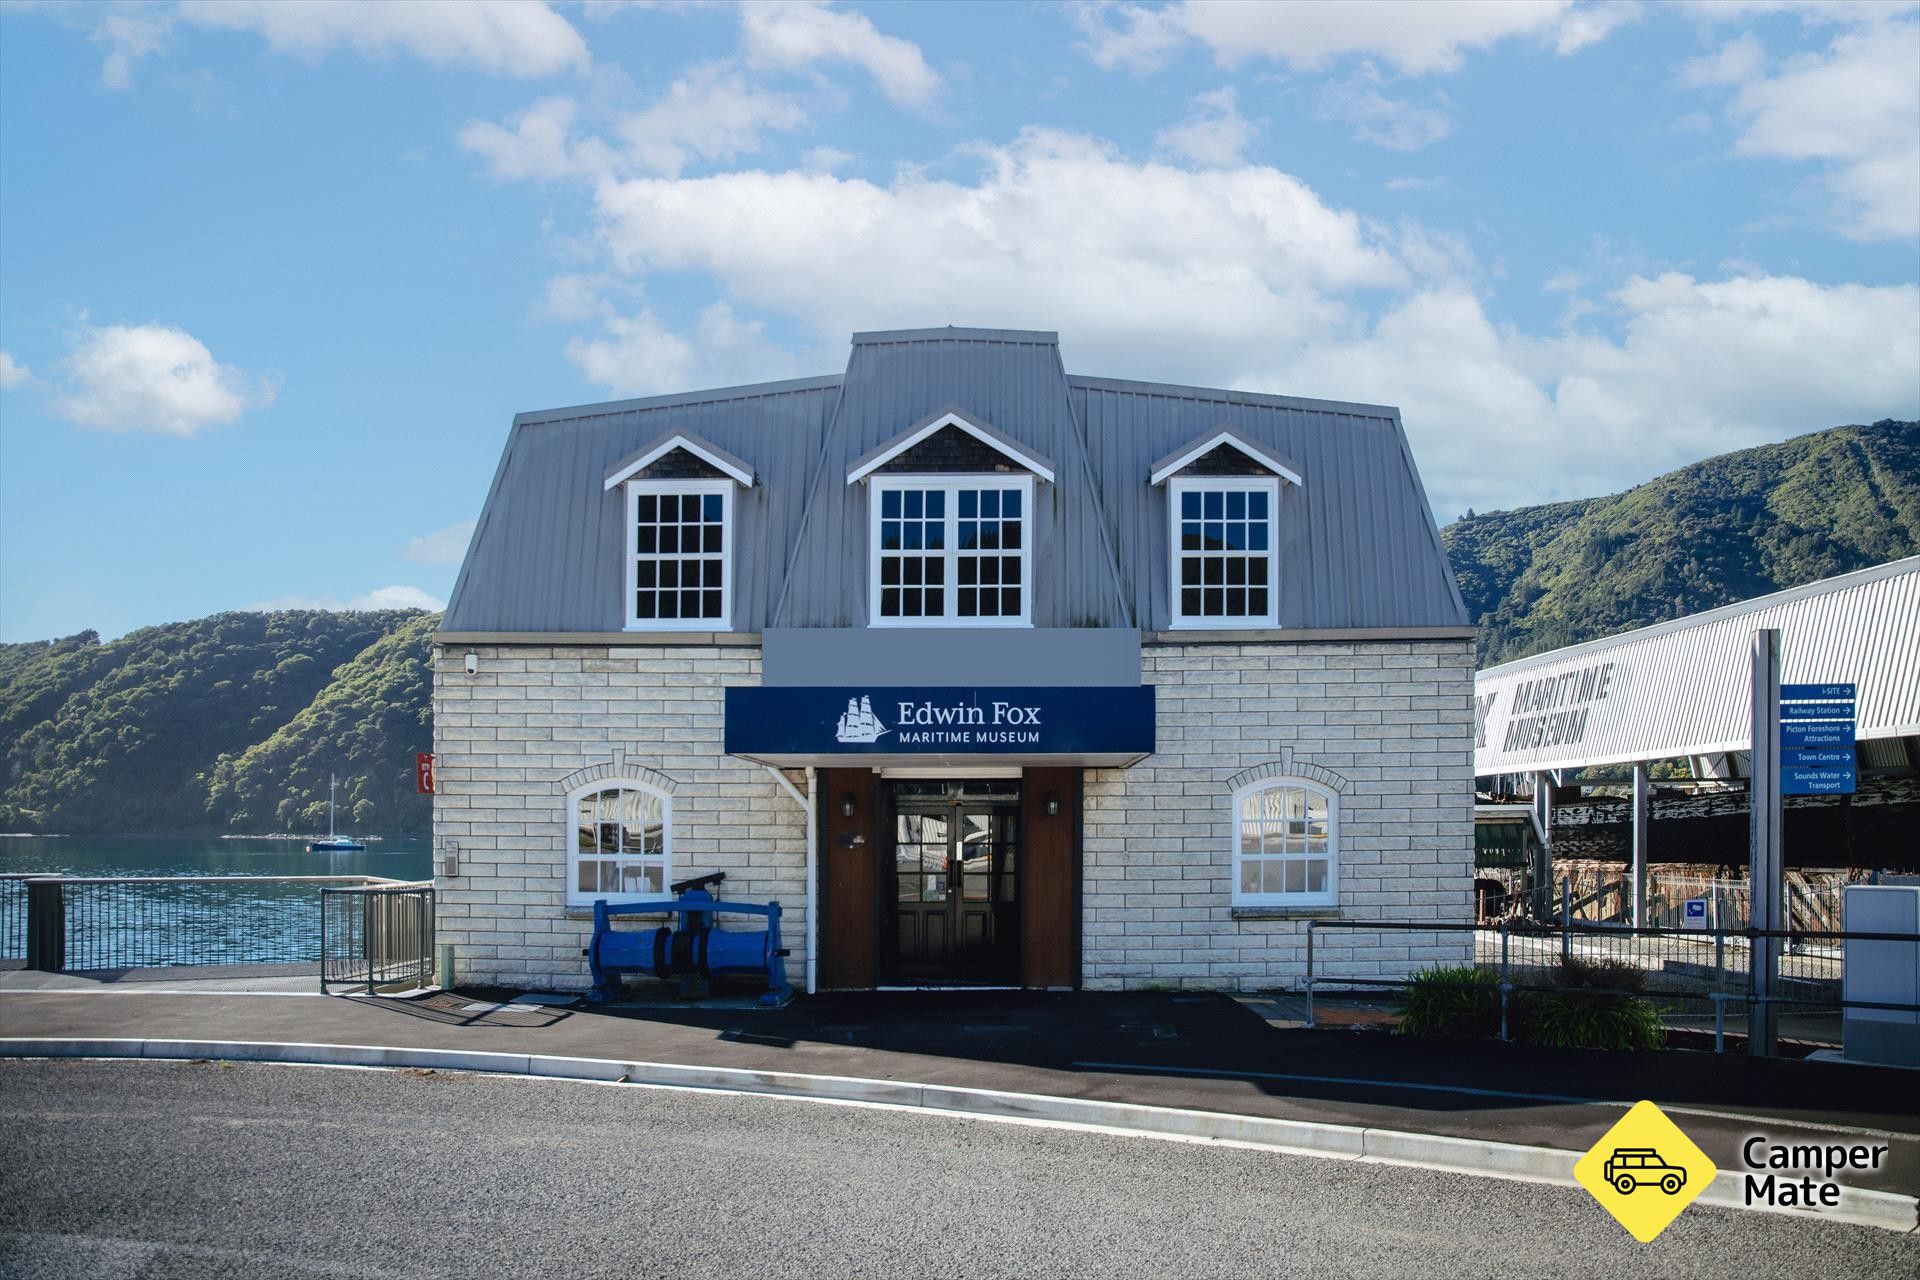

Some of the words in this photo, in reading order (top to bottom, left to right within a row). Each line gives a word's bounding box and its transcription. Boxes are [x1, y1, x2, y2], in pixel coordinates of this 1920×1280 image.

[1512, 662, 1614, 715] MARITIME
[897, 701, 986, 725] Edwin
[991, 701, 1042, 725] Fox
[1789, 706, 1815, 716] Railway
[1816, 706, 1840, 714] Station
[1503, 707, 1589, 752] MUSEUM
[1786, 725, 1807, 733] Picton
[1807, 725, 1841, 733] Foreshore
[899, 731, 970, 743] MARITIME
[976, 731, 1039, 743] MUSEUM
[1803, 734, 1841, 742] Attractions
[1797, 753, 1817, 761] Town
[1818, 753, 1840, 761] Centre
[1794, 772, 1819, 780] Sounds
[1820, 772, 1841, 780] Water
[1808, 782, 1841, 790] Transport
